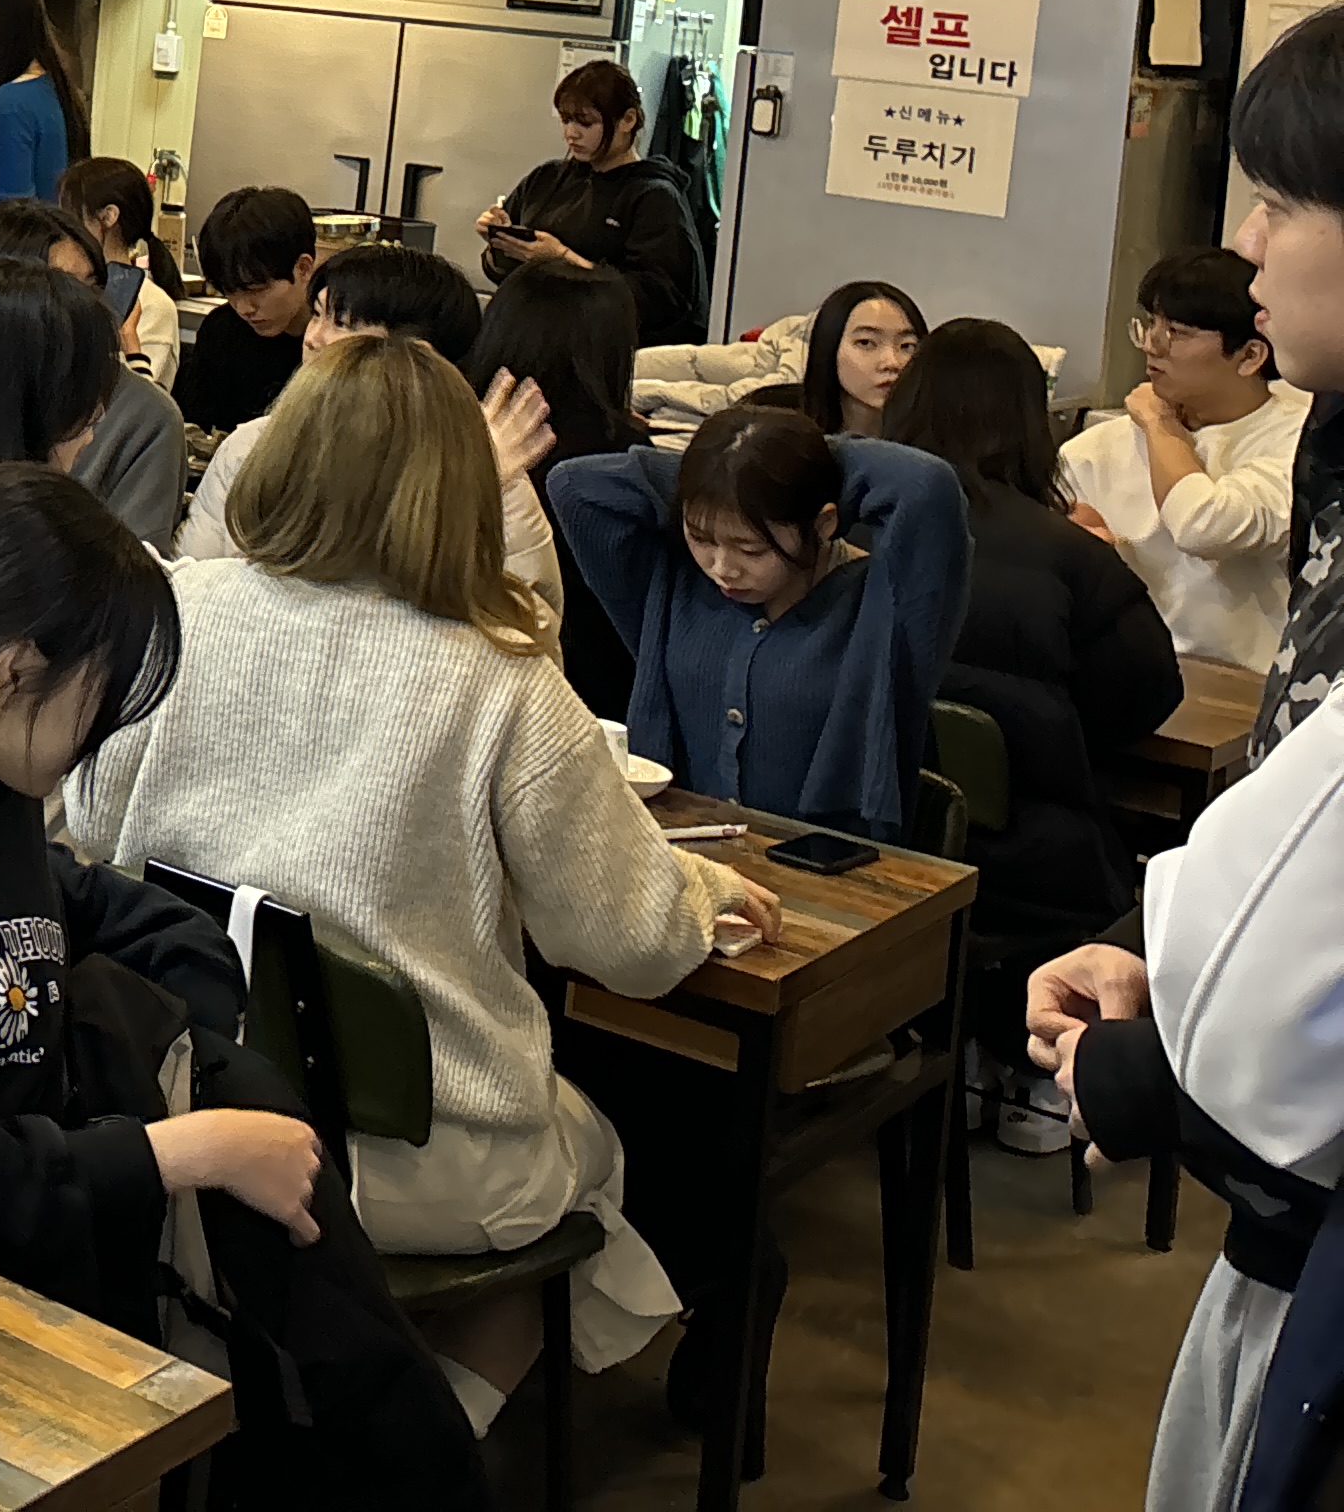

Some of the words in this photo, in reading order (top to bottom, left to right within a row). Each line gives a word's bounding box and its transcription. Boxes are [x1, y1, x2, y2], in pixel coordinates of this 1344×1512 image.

[880, 5, 971, 48] 셀프
[929, 53, 1018, 88] 입니다
[863, 134, 976, 174] 두루치기
